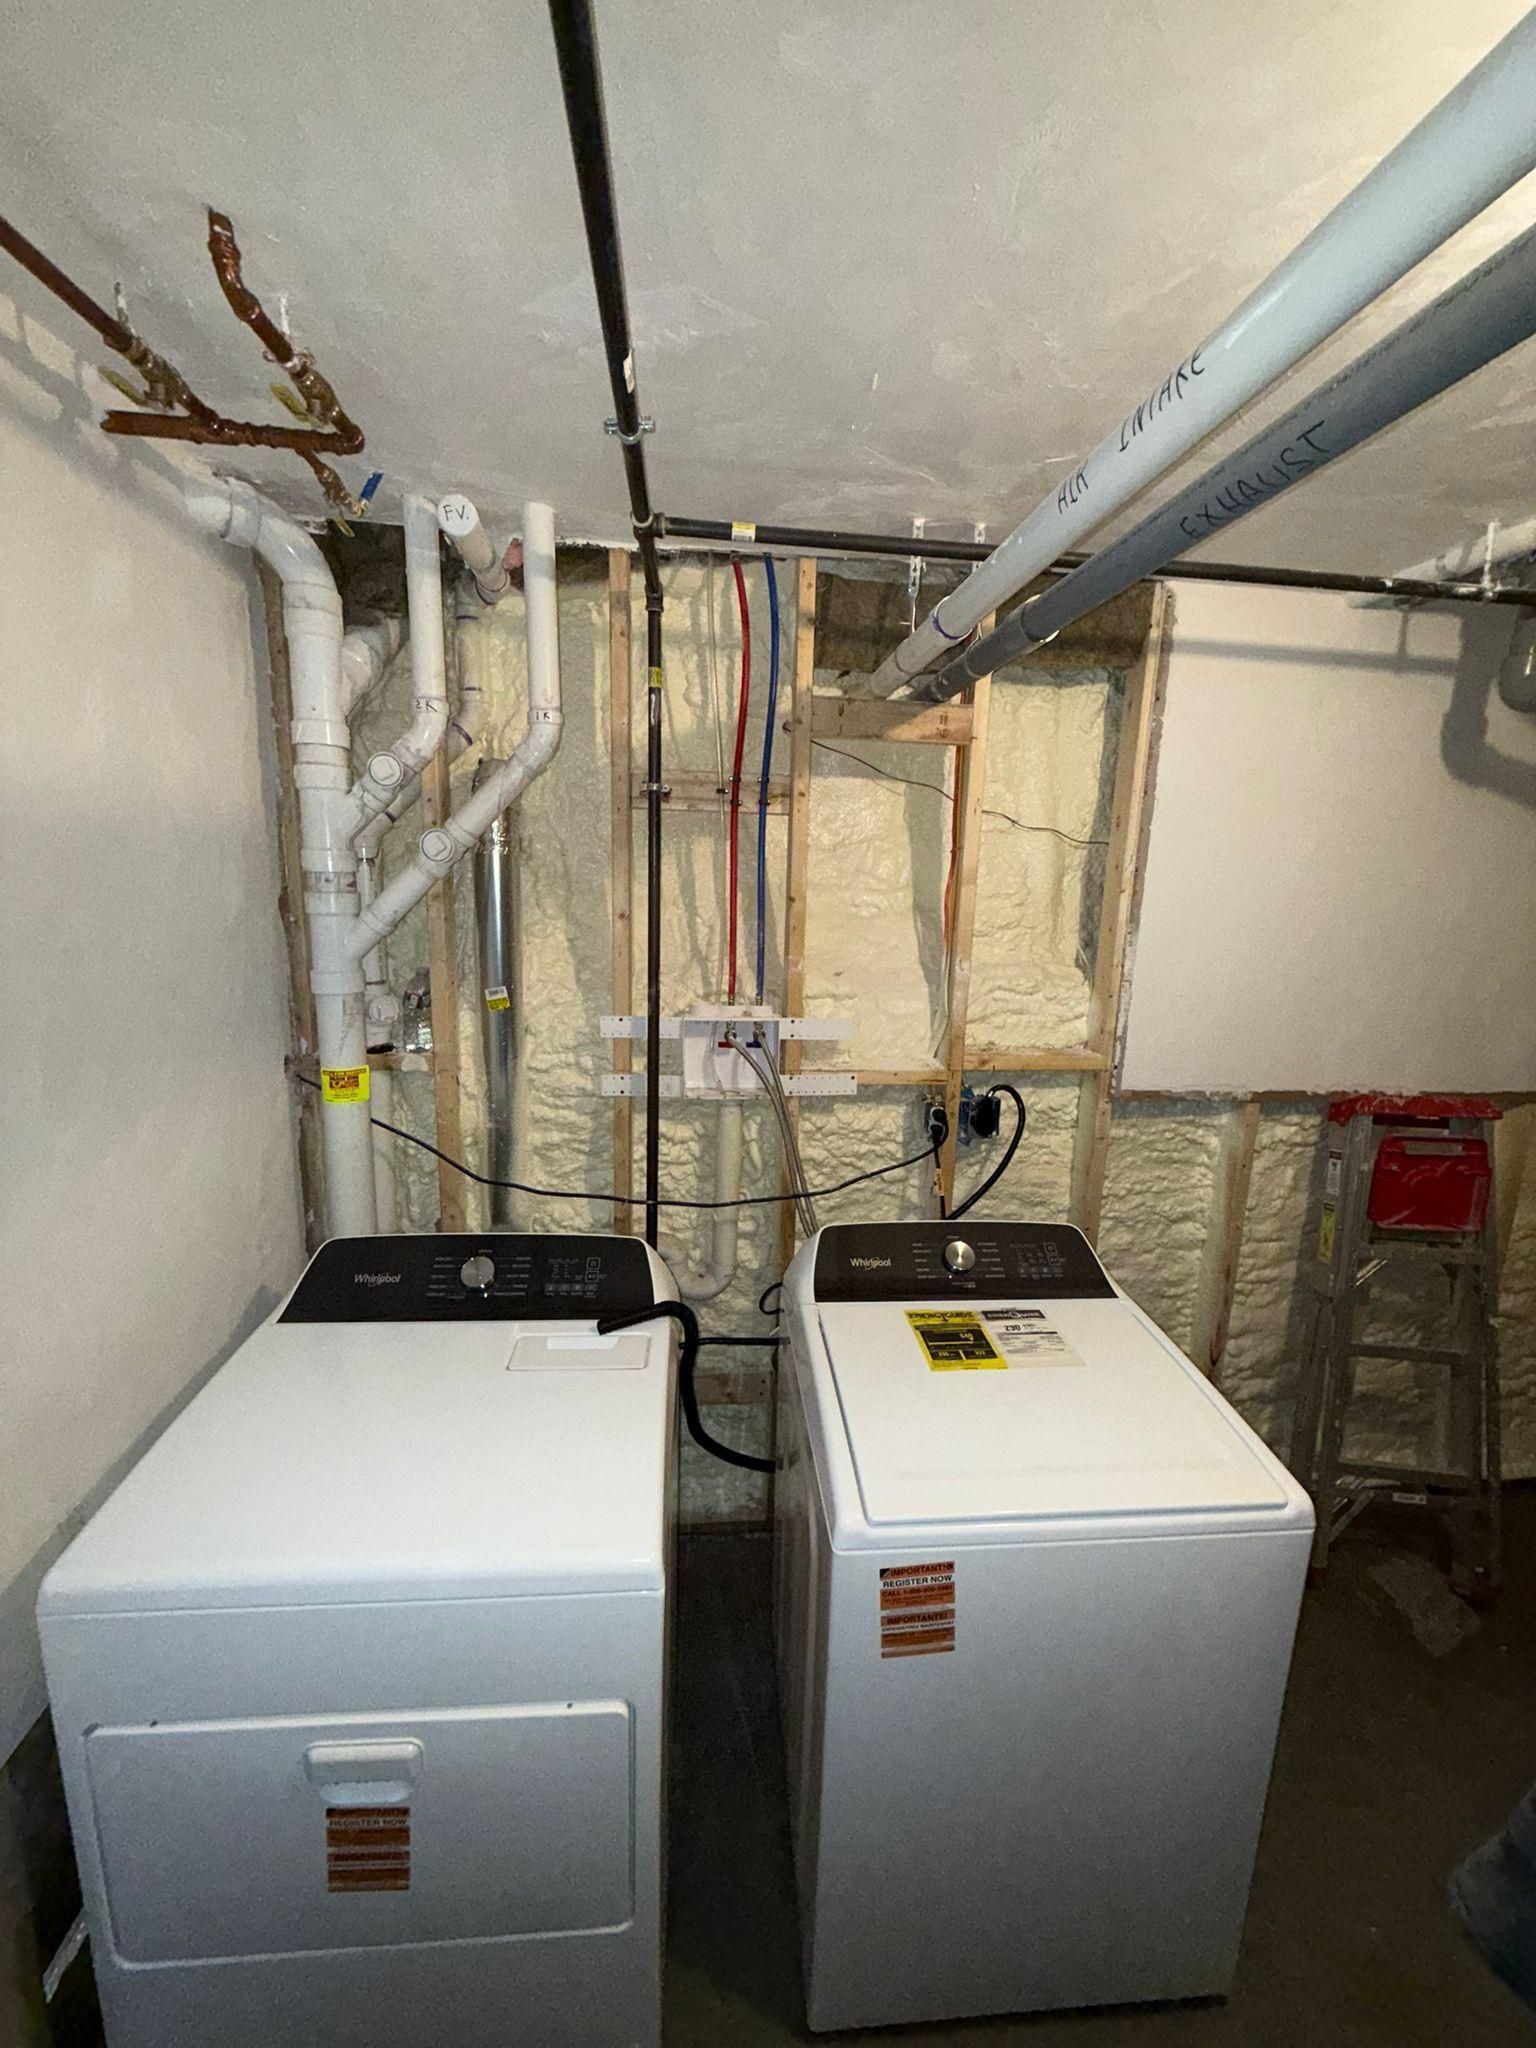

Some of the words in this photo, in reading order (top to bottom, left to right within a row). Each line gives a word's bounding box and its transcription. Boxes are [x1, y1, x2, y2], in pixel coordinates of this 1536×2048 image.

[1179, 419, 1330, 540] EXHAUST
[849, 1256, 892, 1270] Whirlpool
[354, 1273, 401, 1287] Whirlpool
[883, 1576, 929, 1588] REGISTER
[930, 1574, 953, 1583] NOW
